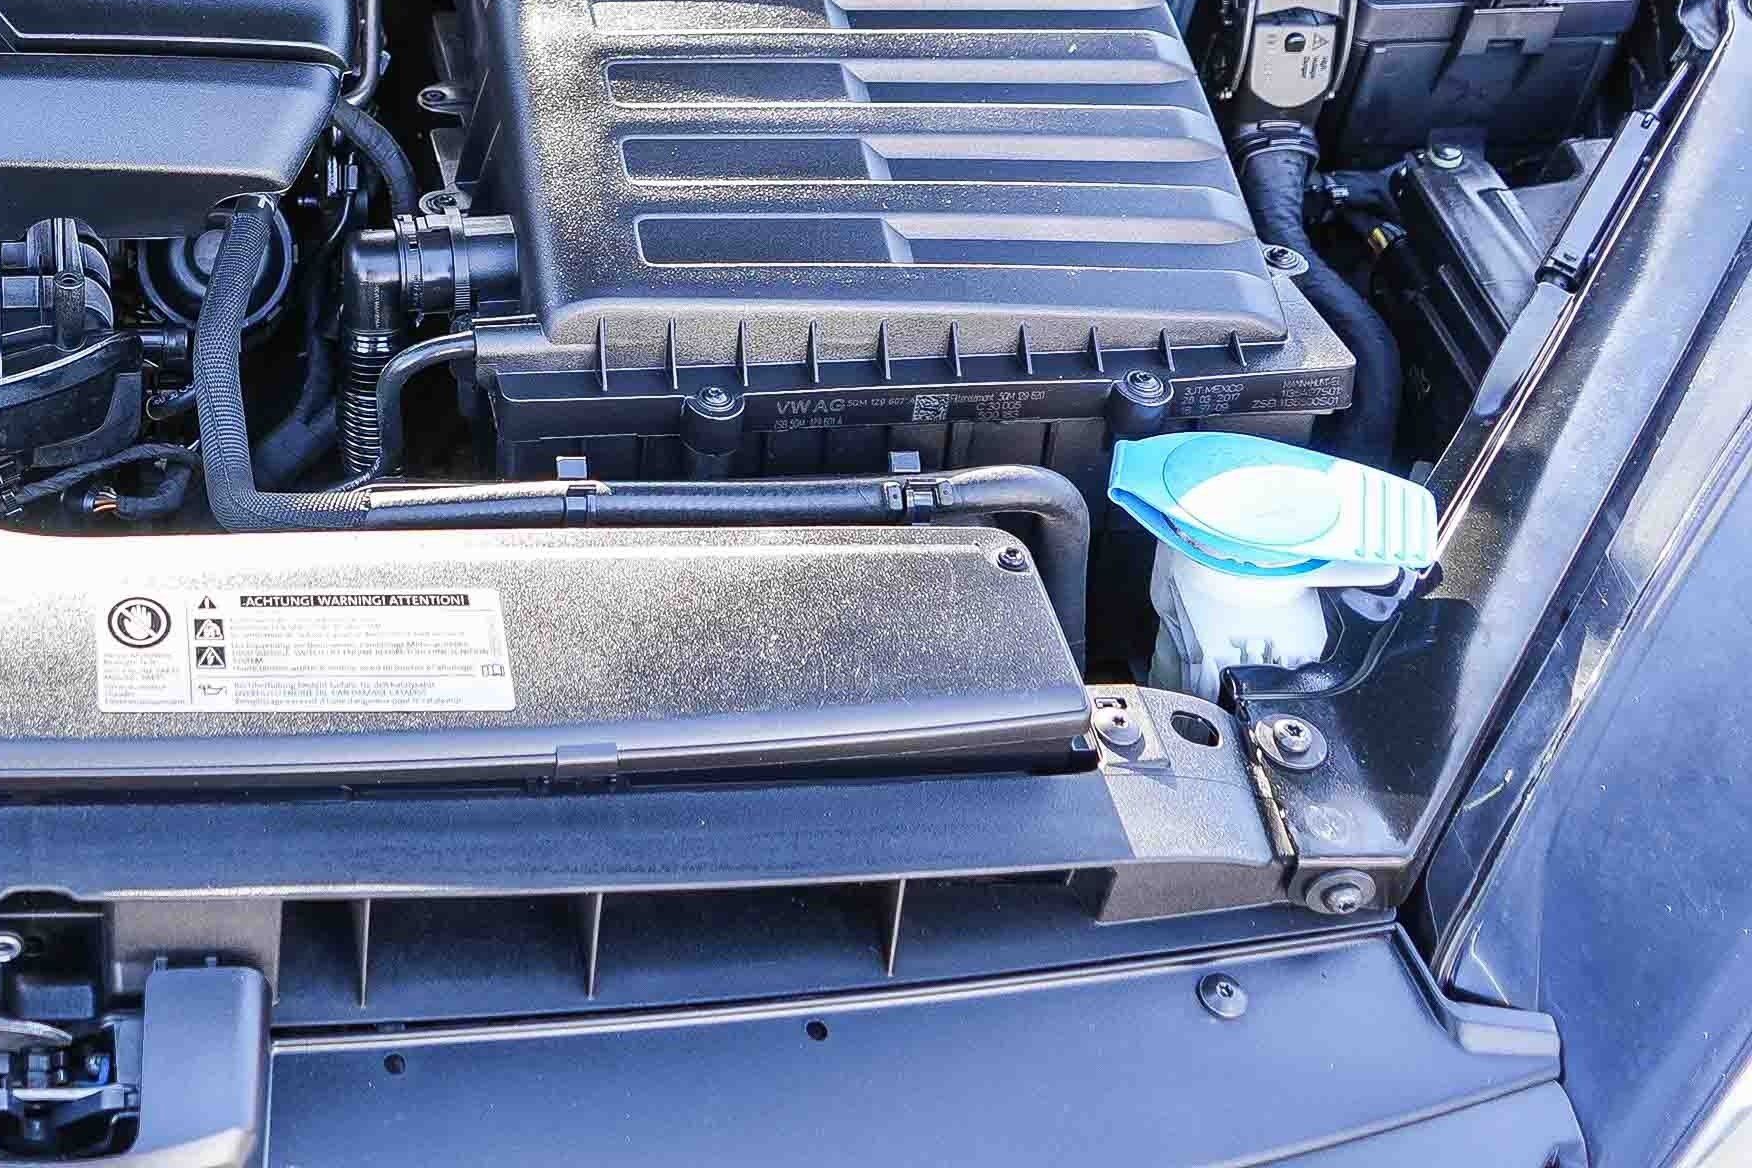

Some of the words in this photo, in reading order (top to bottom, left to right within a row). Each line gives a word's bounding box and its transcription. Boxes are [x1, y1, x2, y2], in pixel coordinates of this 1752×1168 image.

[775, 399, 811, 415] VW
[811, 398, 846, 413] AG
[246, 595, 314, 607] ACHTUNG!
[317, 595, 386, 606] WARNING!
[388, 594, 466, 606] ATTENTION!
